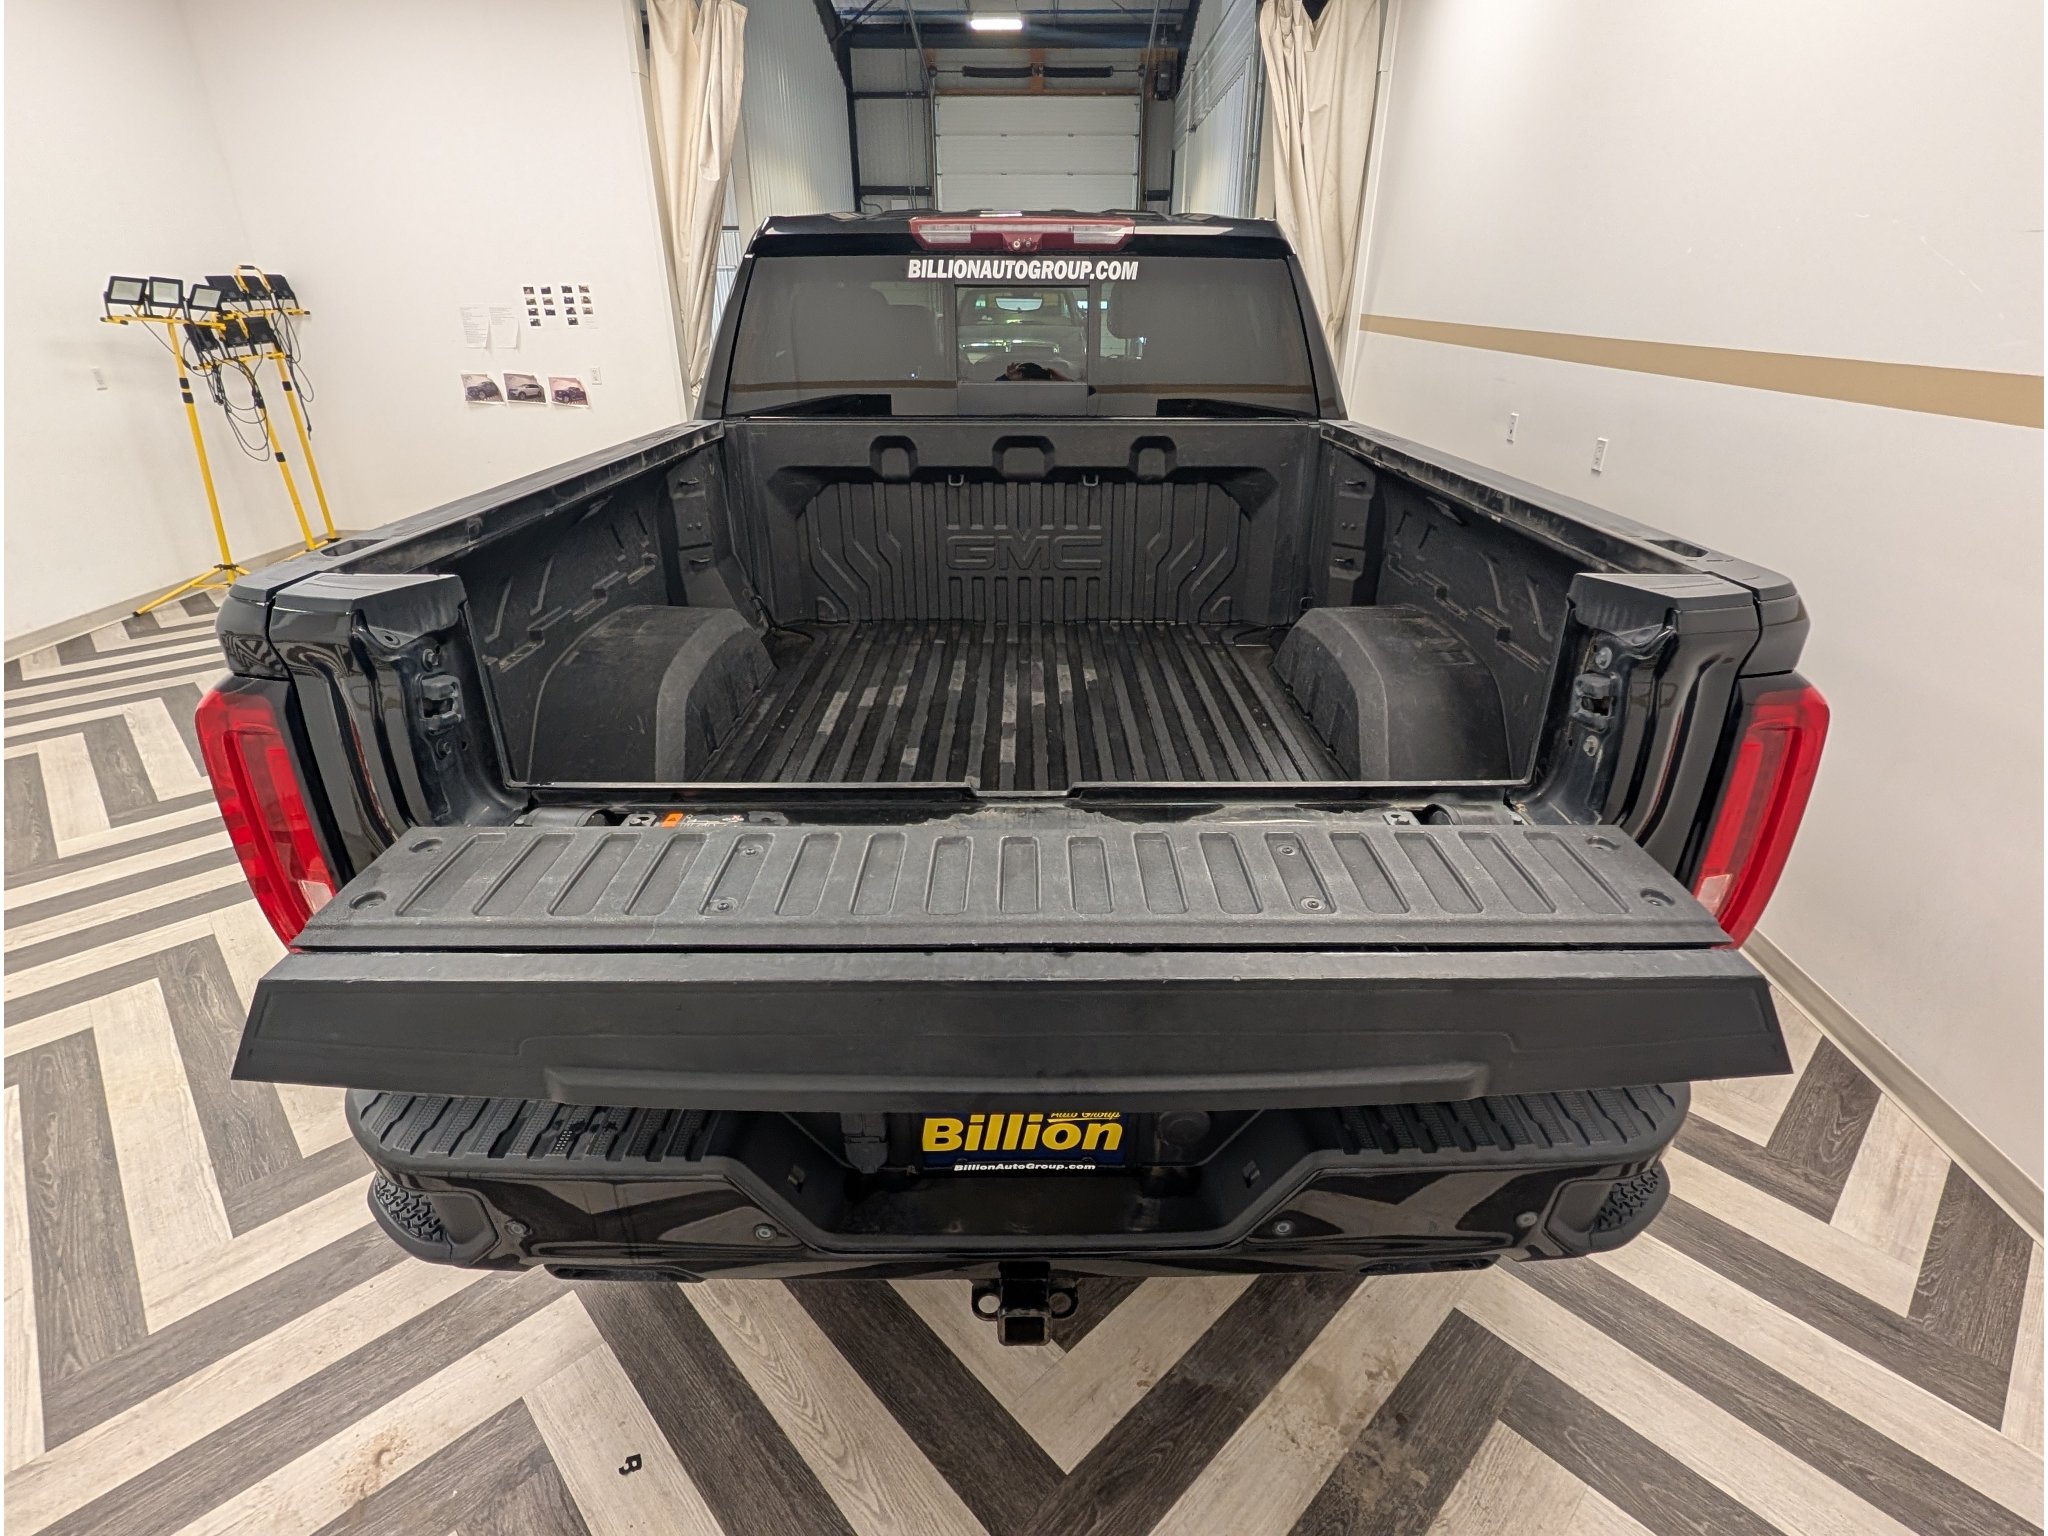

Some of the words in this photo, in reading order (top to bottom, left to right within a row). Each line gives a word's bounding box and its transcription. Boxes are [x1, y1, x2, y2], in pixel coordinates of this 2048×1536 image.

[908, 259, 1139, 280] BILLIONAUTOGROUP.COM
[947, 535, 1102, 570] GMC
[922, 1113, 1123, 1152] Billion
[953, 1163, 1096, 1171] BillionAutoGroup.com
